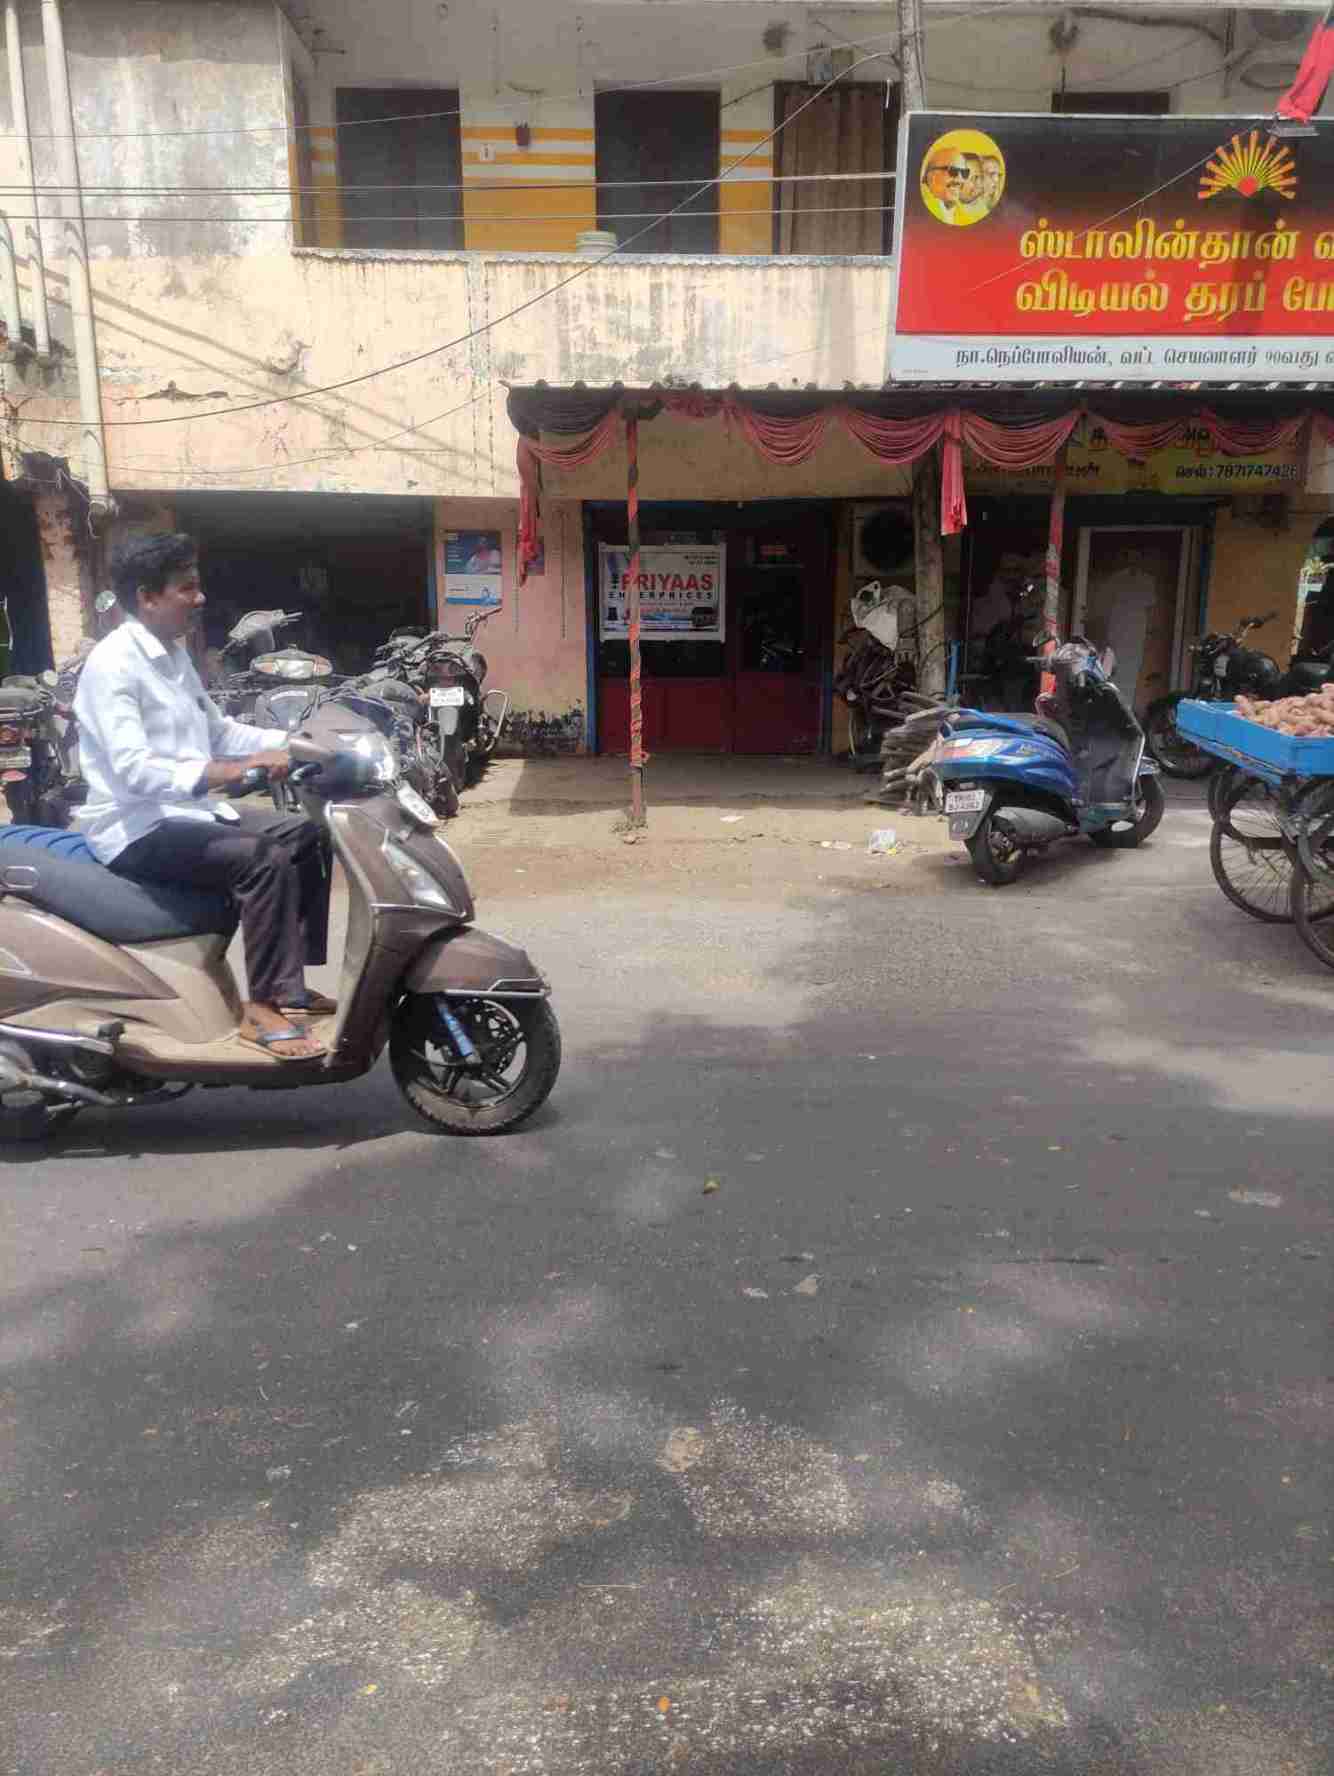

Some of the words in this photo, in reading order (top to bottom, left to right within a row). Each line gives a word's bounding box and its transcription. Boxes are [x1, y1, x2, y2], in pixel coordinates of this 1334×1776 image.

[1020, 218, 1299, 269] ஸ்டாலின்தான்
[1016, 268, 1170, 317] விடியல்
[1184, 270, 1266, 321] தரப்
